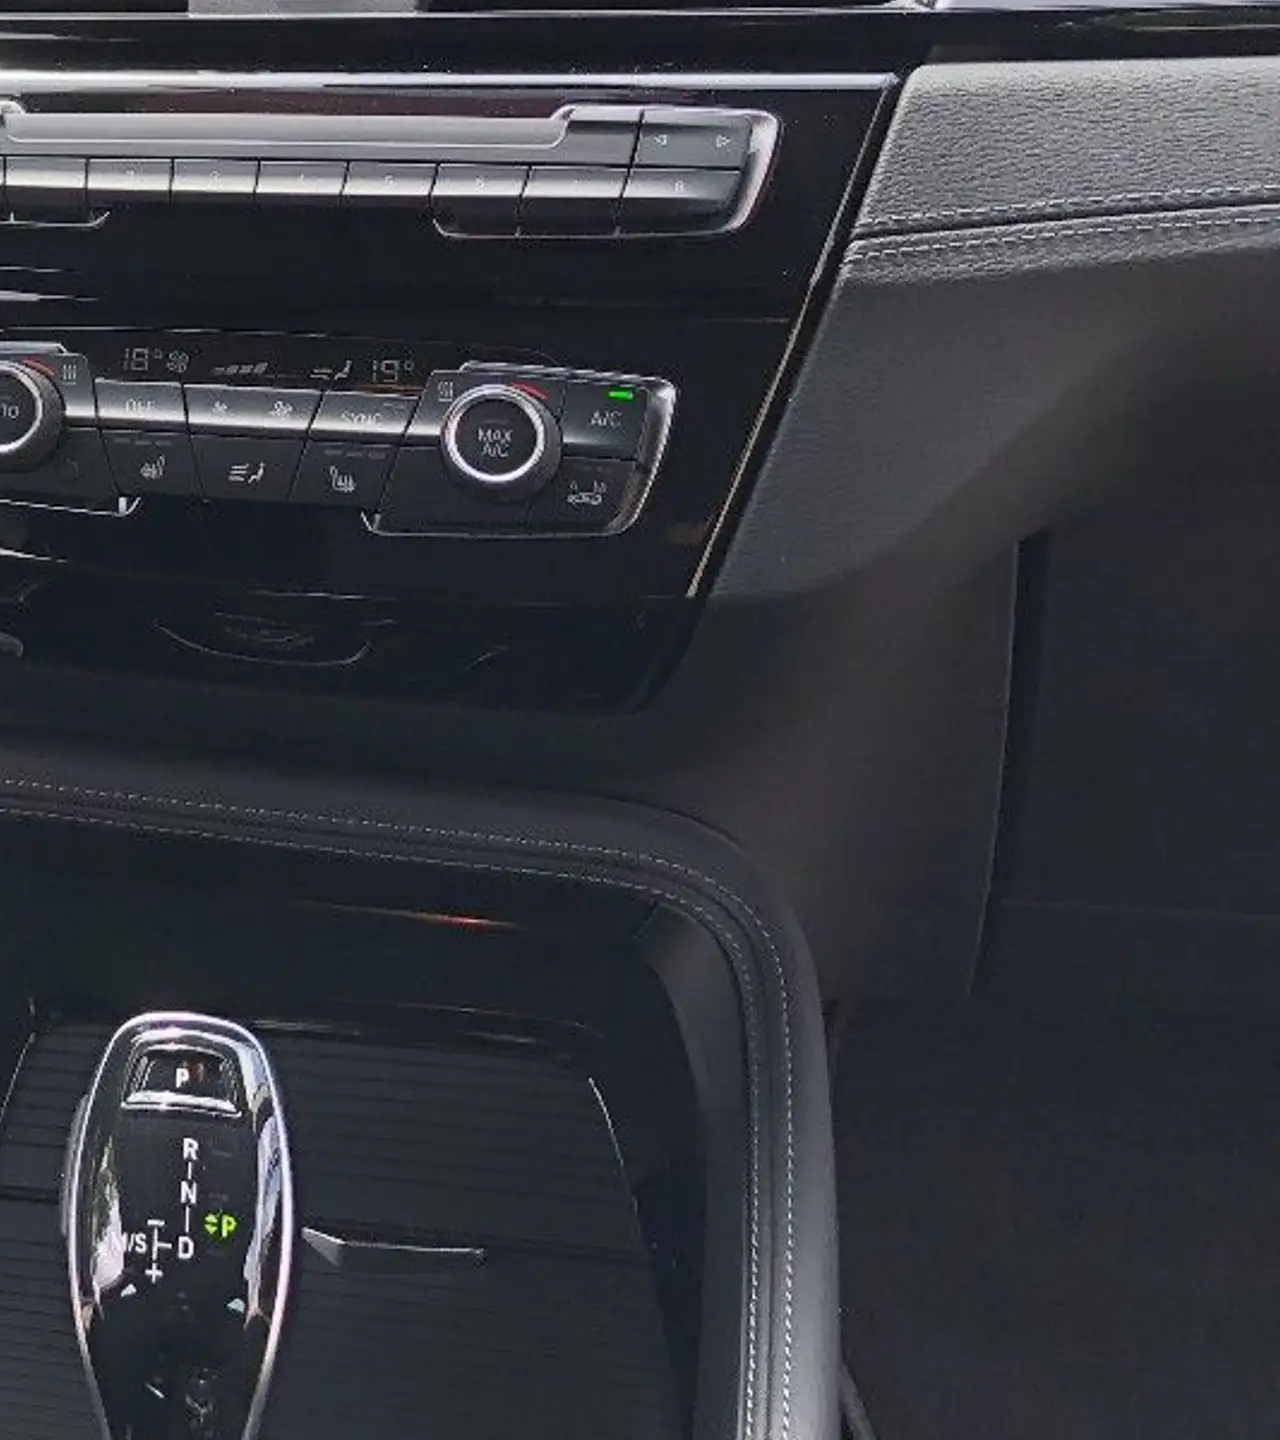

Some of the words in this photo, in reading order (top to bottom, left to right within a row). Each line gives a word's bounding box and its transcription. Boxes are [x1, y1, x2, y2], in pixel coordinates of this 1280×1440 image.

[590, 409, 623, 428] A/C
[477, 427, 514, 443] MAX
[175, 1067, 190, 1088] P
[182, 1137, 199, 1160] R
[180, 1180, 198, 1204] N
[178, 1235, 195, 1259] D
